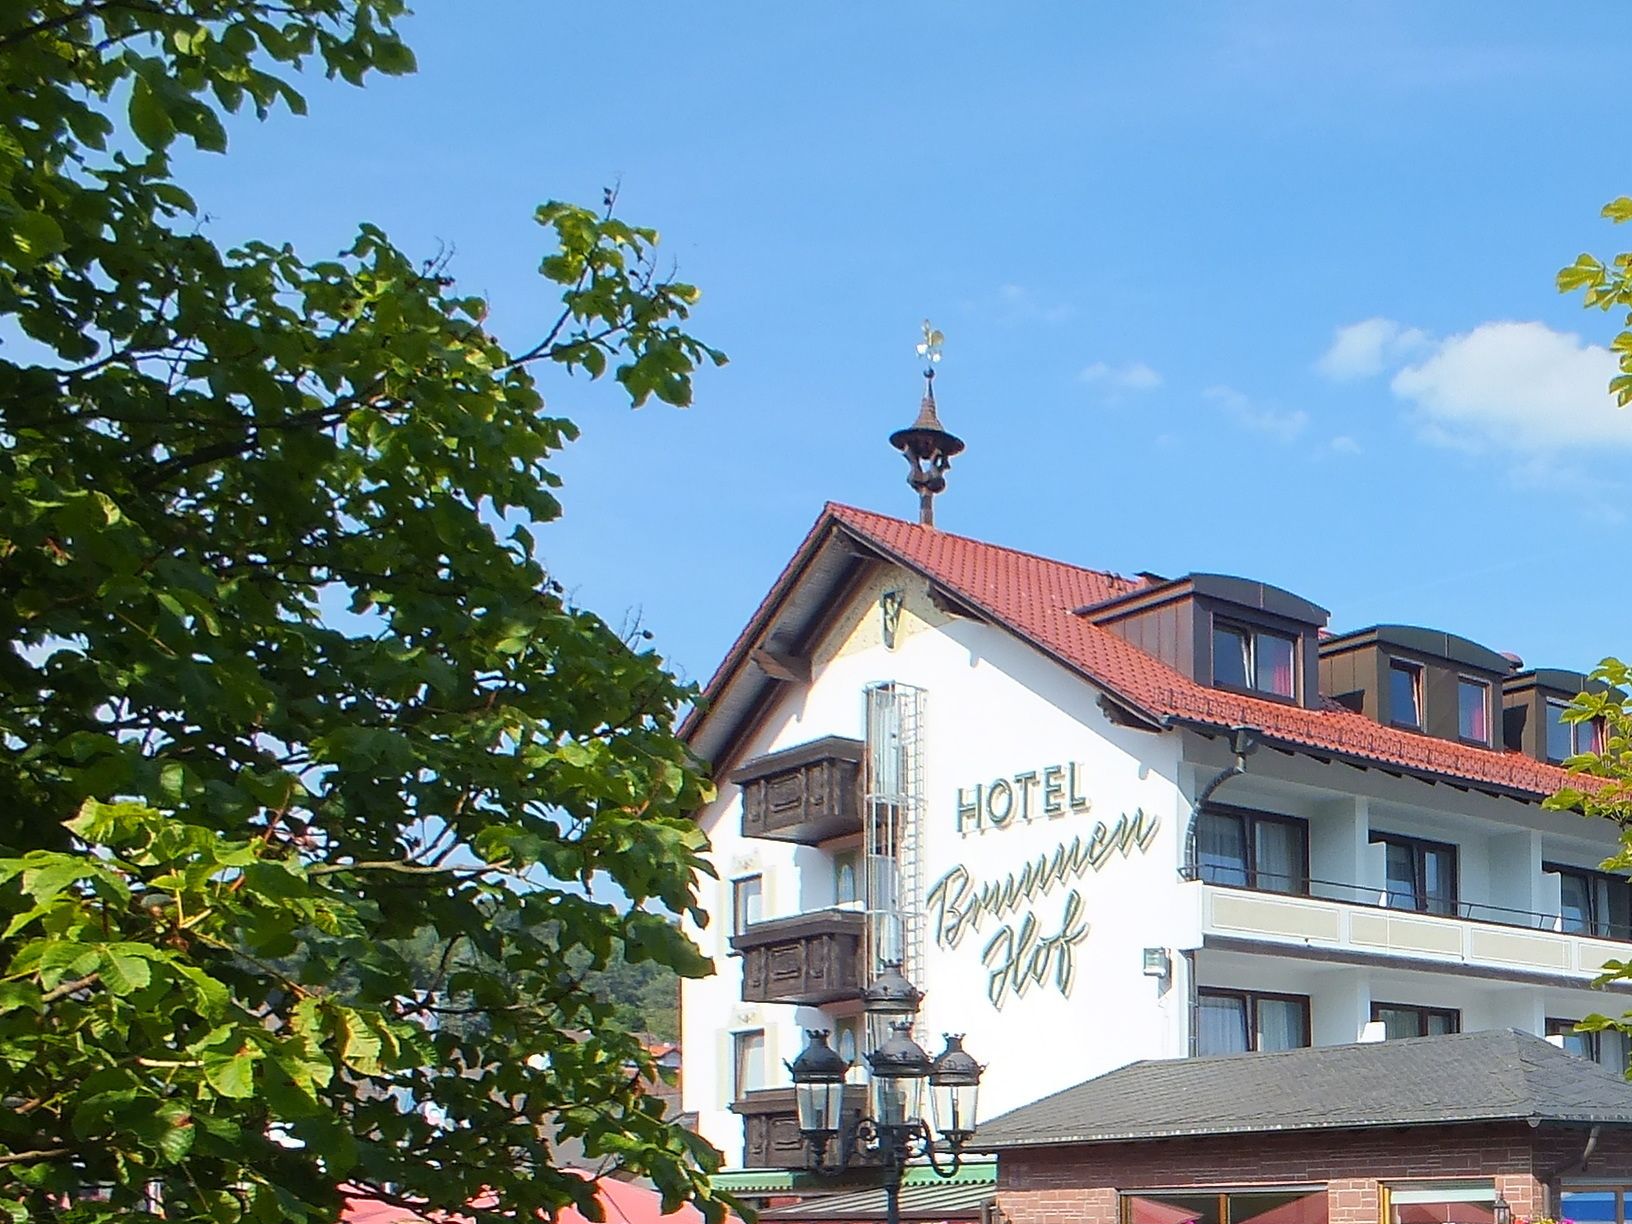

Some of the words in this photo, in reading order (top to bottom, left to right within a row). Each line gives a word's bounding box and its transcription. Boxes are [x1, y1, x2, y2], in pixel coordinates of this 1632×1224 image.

[957, 761, 1089, 833] HOTEL
[926, 808, 1160, 950] Brunnen
[982, 889, 1090, 1011] Hof
